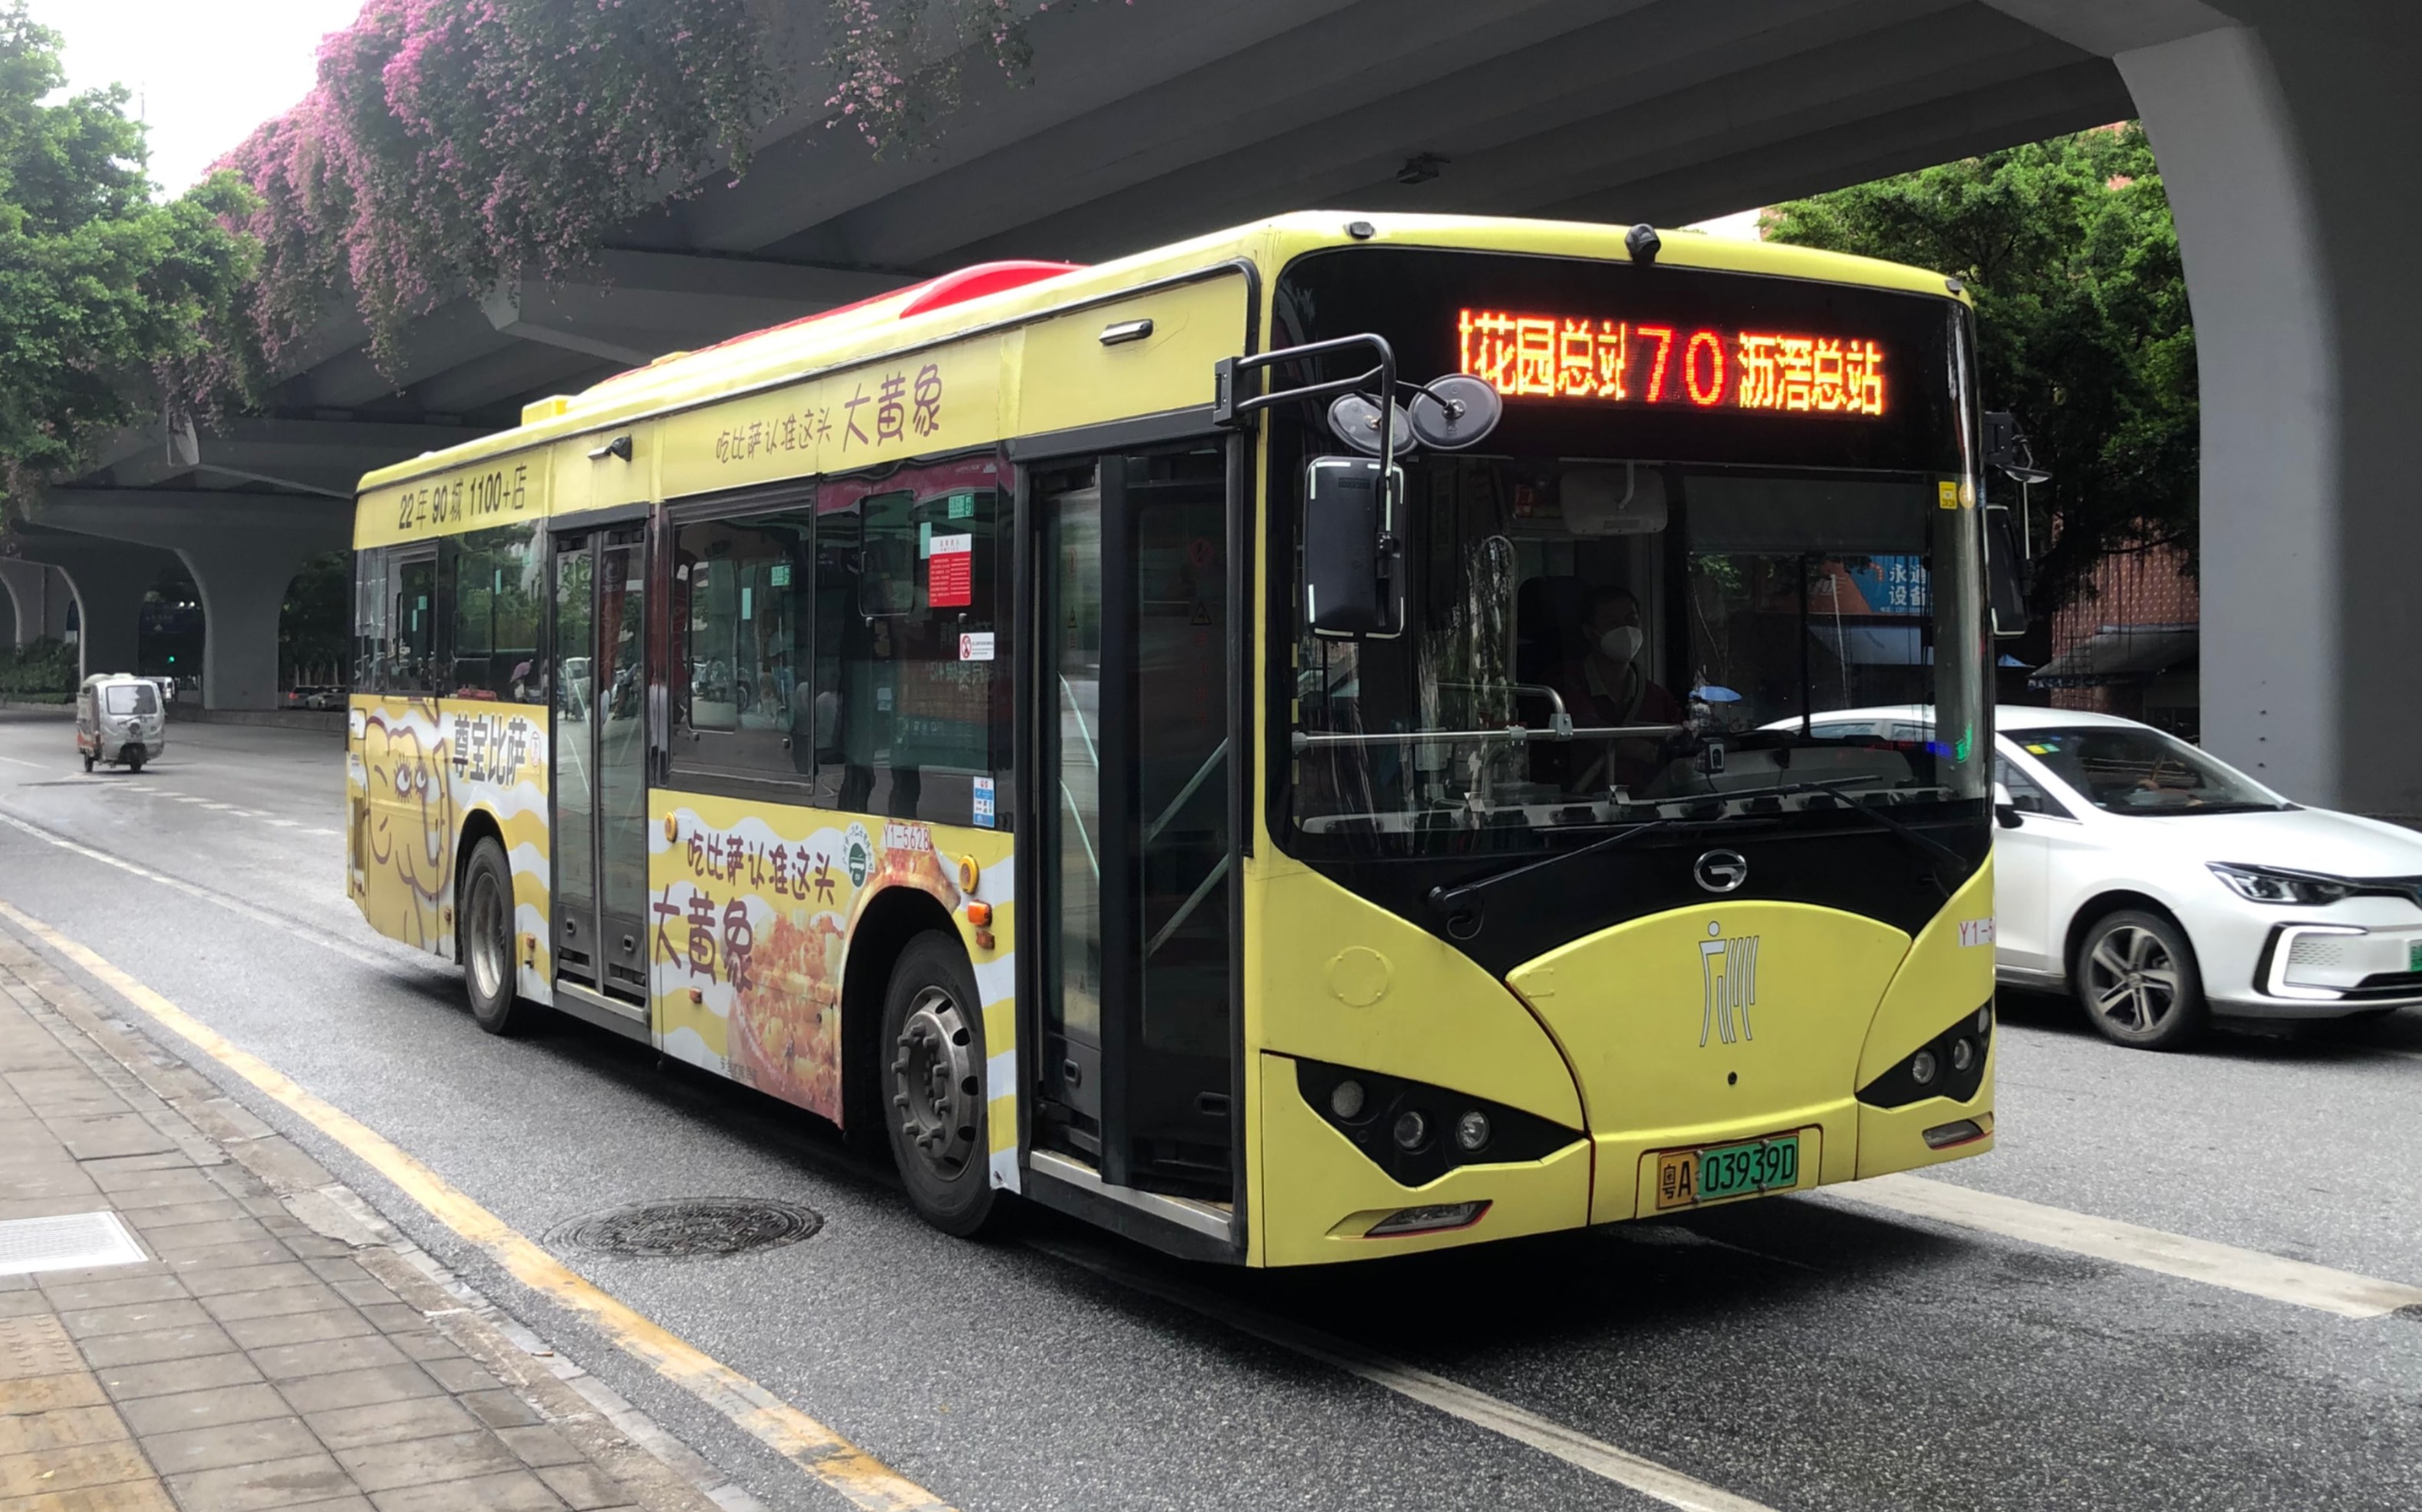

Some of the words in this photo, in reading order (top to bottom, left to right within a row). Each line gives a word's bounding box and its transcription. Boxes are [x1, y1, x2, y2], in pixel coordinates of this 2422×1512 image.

[1636, 327, 1724, 406] 70
[1737, 331, 1883, 416] 沥滘总站
[715, 407, 832, 464] 吃比萨认准这头
[843, 363, 943, 453] 大黄象
[452, 712, 529, 787] 尊宝比萨
[687, 829, 835, 906] 吃比萨认准这头
[884, 825, 930, 852] Y1-5628
[653, 883, 753, 993] 大黄象
[1662, 1160, 1692, 1200] 粤A
[1705, 1144, 1796, 1192] 03939D
